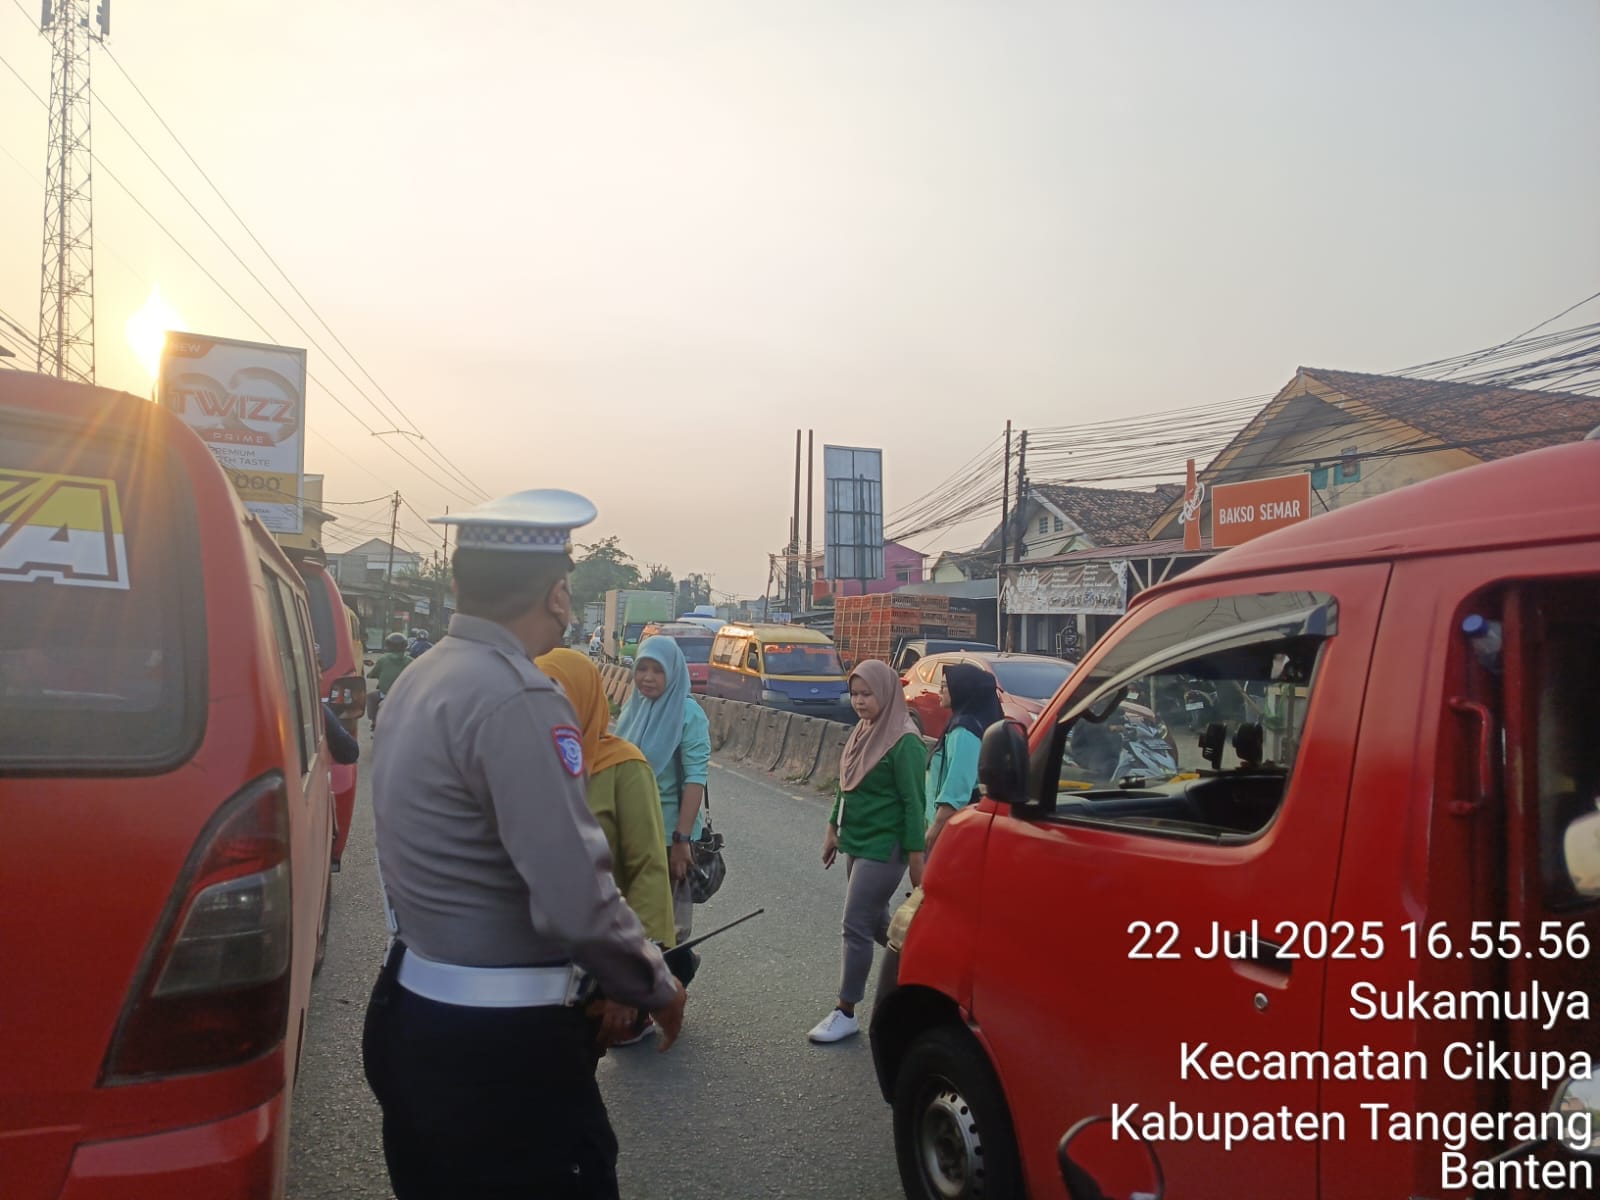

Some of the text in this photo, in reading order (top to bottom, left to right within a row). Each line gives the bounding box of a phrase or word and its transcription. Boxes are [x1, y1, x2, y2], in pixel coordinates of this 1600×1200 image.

[170, 388, 296, 424] TWIZZ
[213, 431, 265, 444] PRIME
[1219, 500, 1301, 524] BAKSO SEMAR
